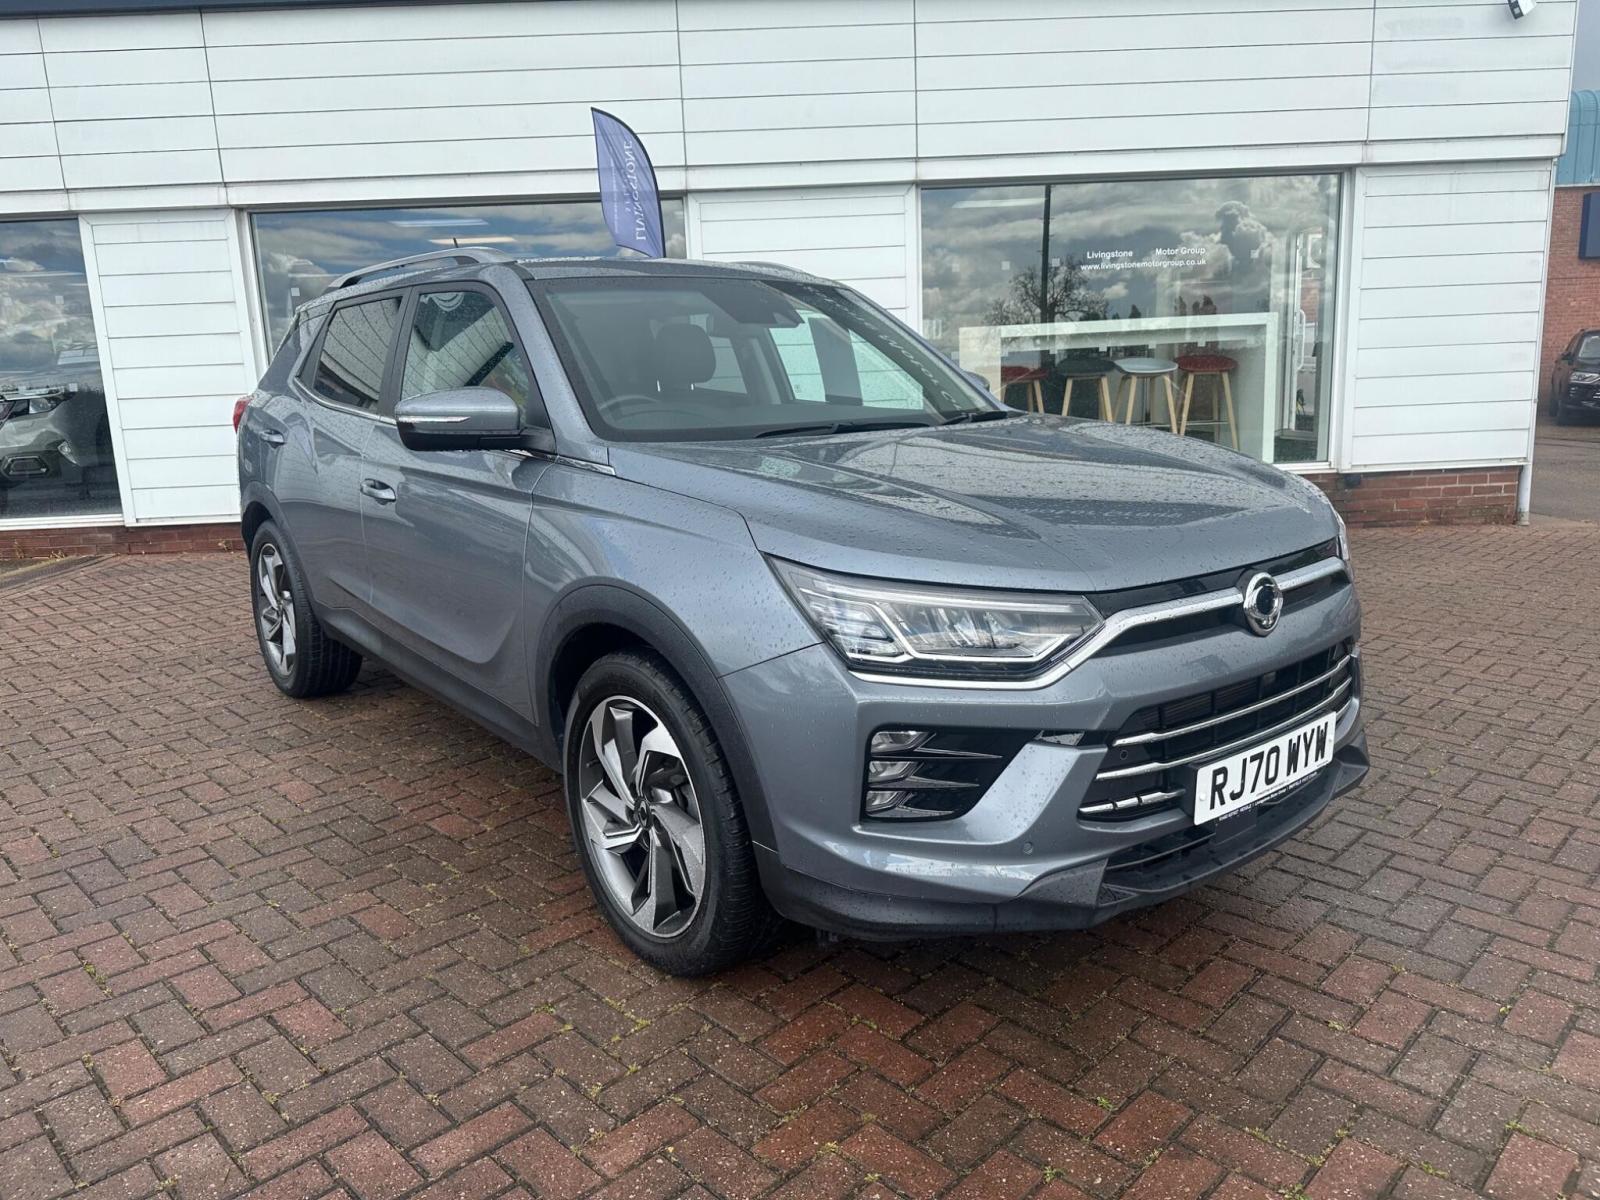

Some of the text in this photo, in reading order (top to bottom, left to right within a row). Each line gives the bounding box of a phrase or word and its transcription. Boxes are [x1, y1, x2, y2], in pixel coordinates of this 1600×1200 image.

[1086, 246, 1206, 259] Livingstone Motor Group
[1080, 258, 1206, 271] www.livingstonemotorgroup.co.uk
[1209, 745, 1280, 811] RJ70
[1286, 721, 1329, 777] WYW
